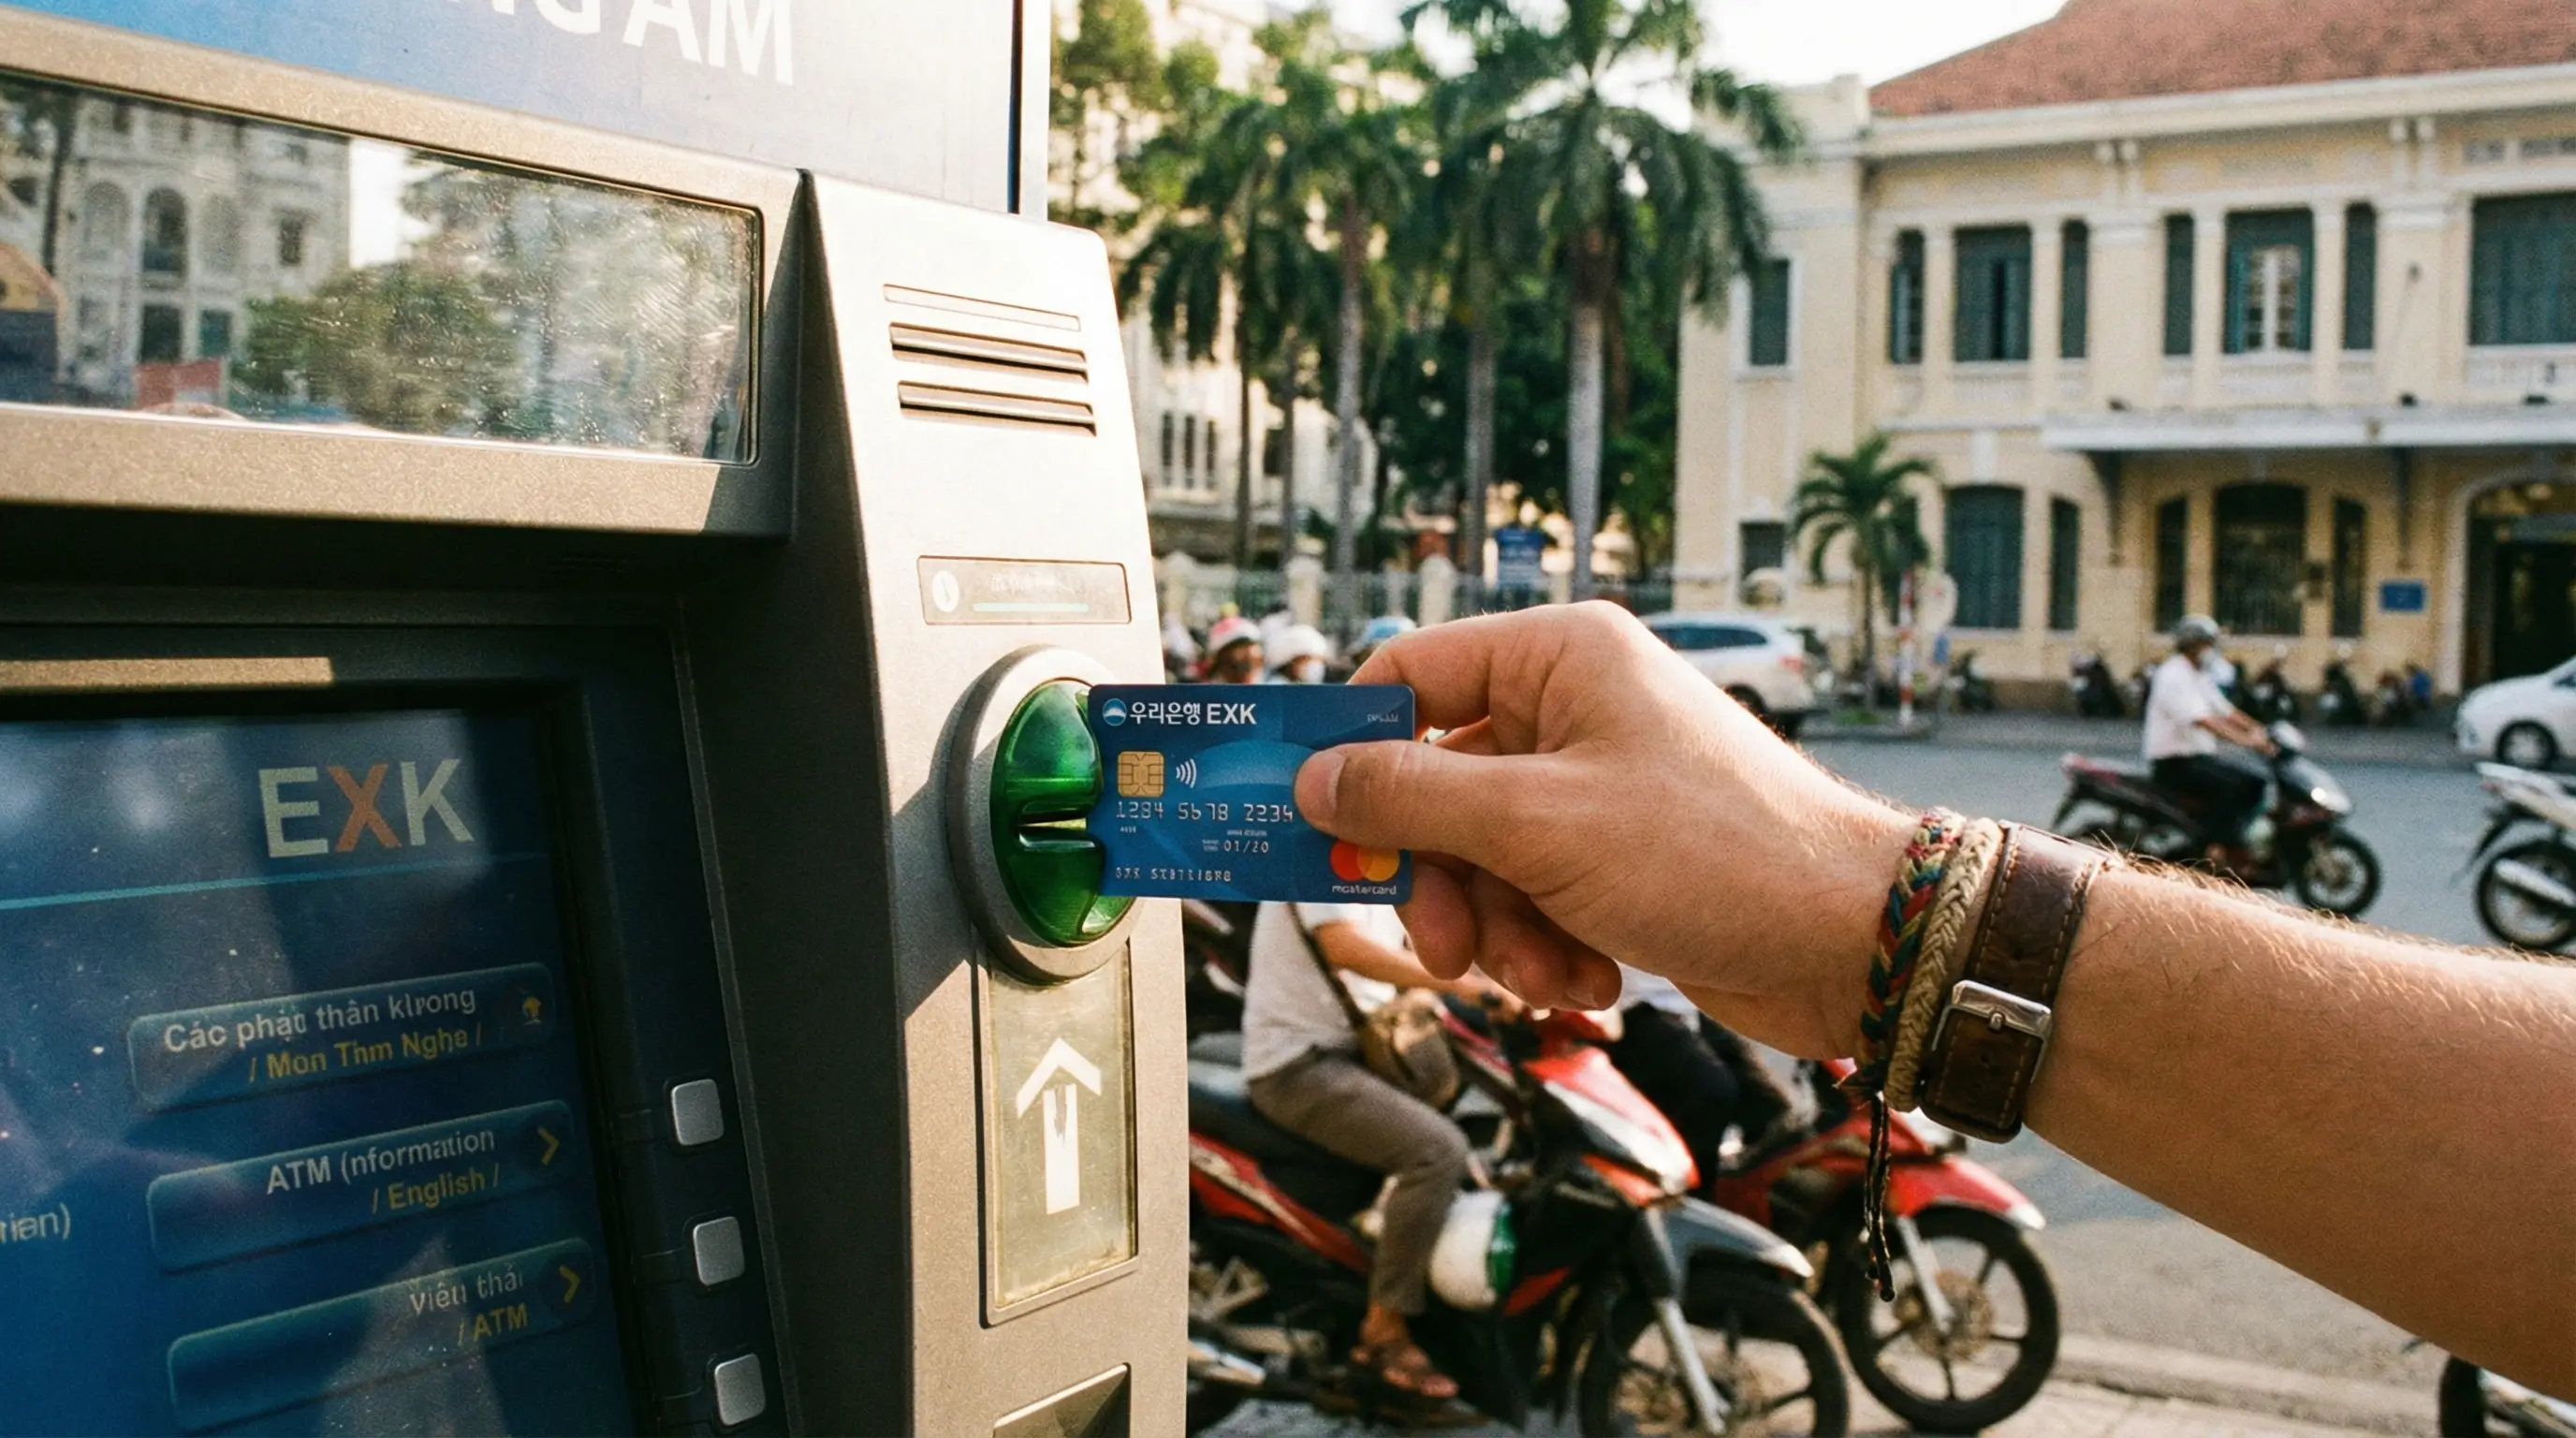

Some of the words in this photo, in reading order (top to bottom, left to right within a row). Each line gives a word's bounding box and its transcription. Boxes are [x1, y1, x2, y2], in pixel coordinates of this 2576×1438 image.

[1130, 702, 1201, 726] 우리은행
[1207, 703, 1257, 725] EXK
[258, 759, 475, 858] EXK
[1244, 803, 1294, 822] 2234
[1223, 840, 1269, 853] 01/20
[164, 1020, 227, 1053] Các
[315, 998, 380, 1030] thân
[266, 1050, 328, 1078] Mon
[266, 1155, 331, 1195] ATM
[388, 1170, 486, 1210] English
[473, 1302, 528, 1342] ATM
